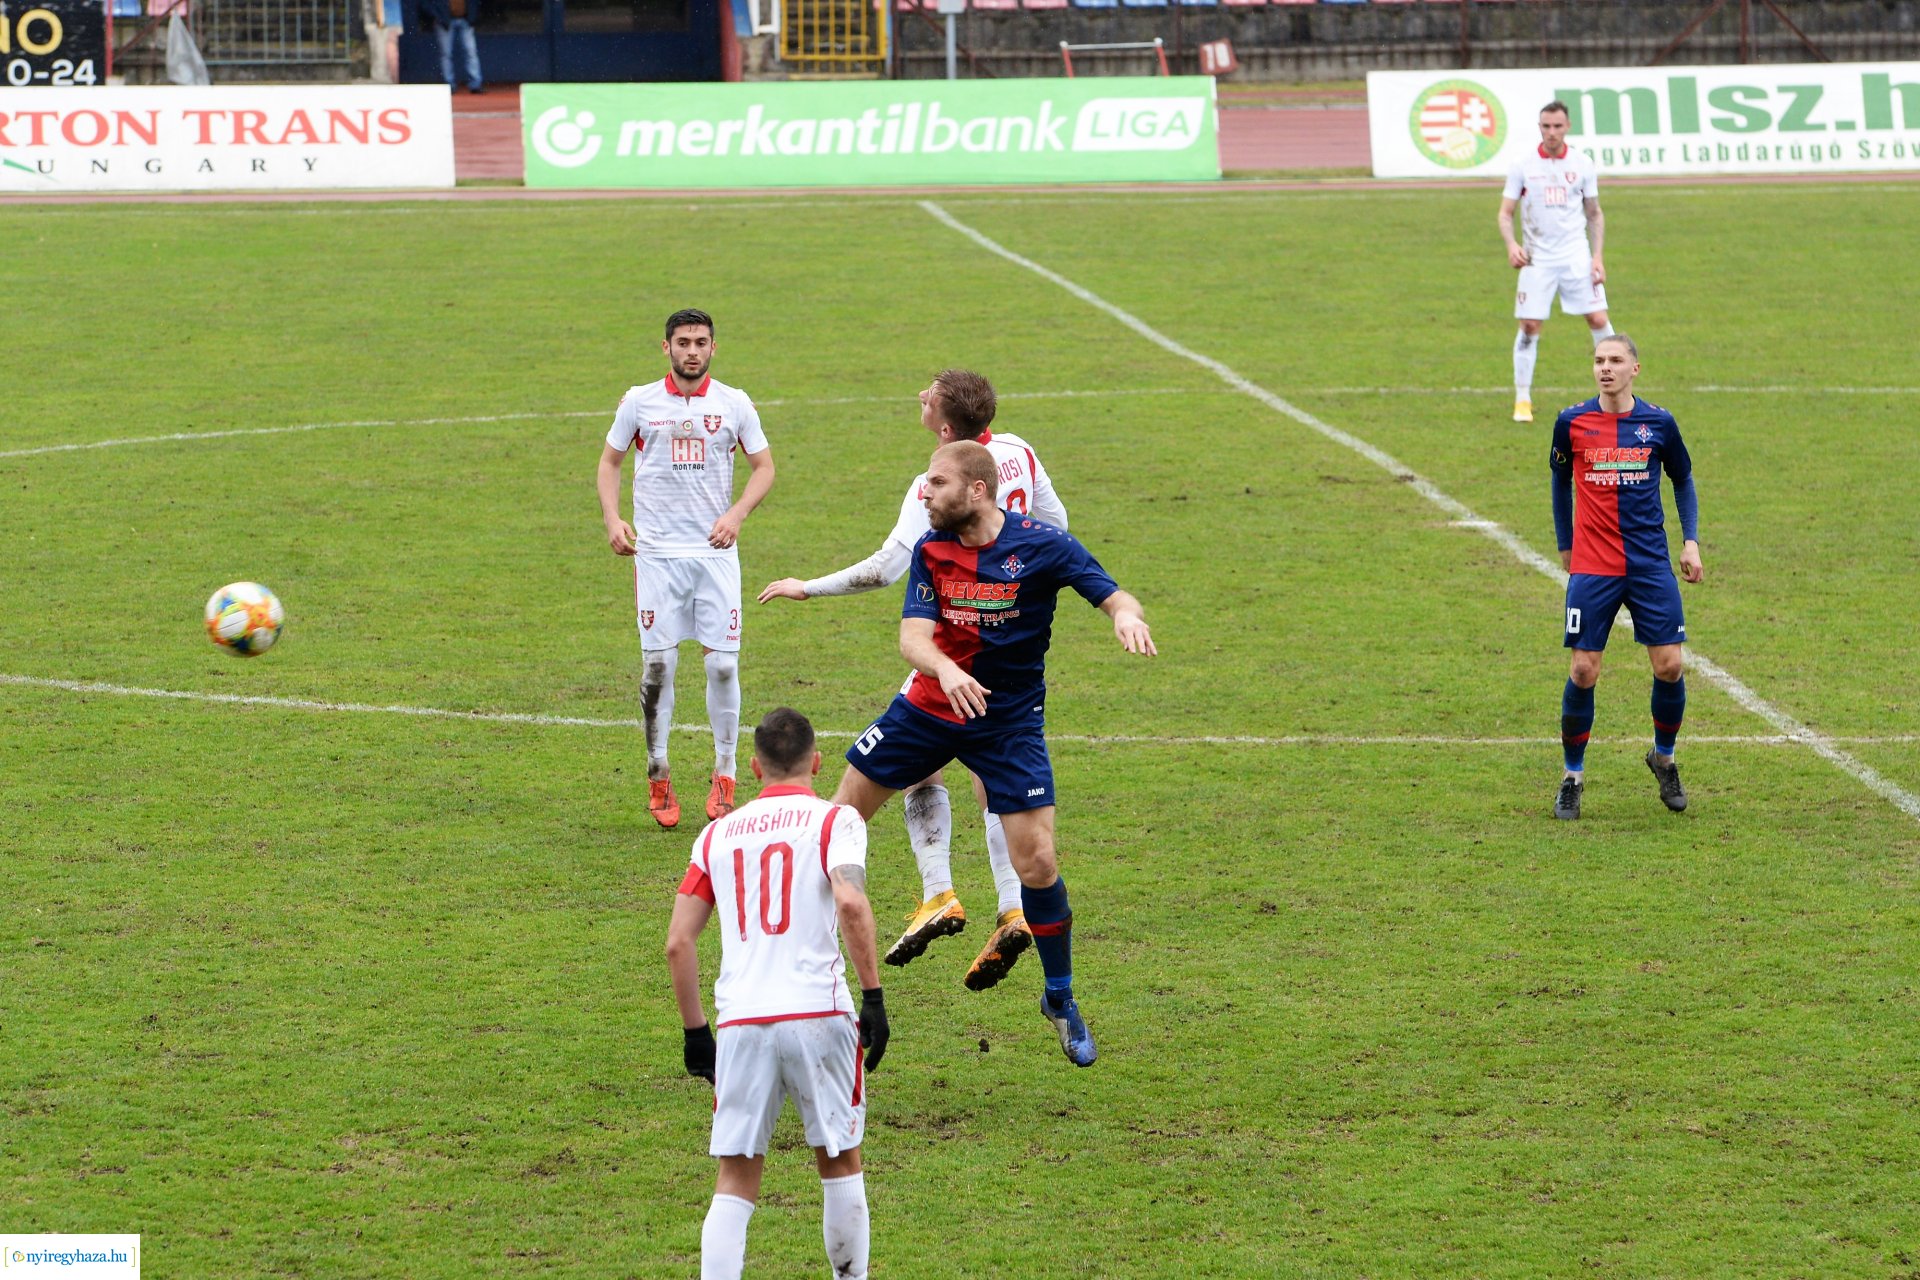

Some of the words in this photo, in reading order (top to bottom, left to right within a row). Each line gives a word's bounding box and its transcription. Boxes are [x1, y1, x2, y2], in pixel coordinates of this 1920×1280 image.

[0, 9, 63, 55] O
[7, 59, 96, 86] 0-24
[182, 108, 412, 146] TRANS
[616, 100, 1067, 155] merkantilbank
[1090, 110, 1189, 138] LIGA
[1582, 145, 1665, 165] agyar
[673, 440, 703, 461] HR
[1585, 448, 1652, 463] REVESZ
[941, 580, 1021, 600] REVESZ
[1027, 787, 1045, 797] JAKO
[725, 808, 812, 838] HARSÁNYI
[733, 842, 793, 942] 10
